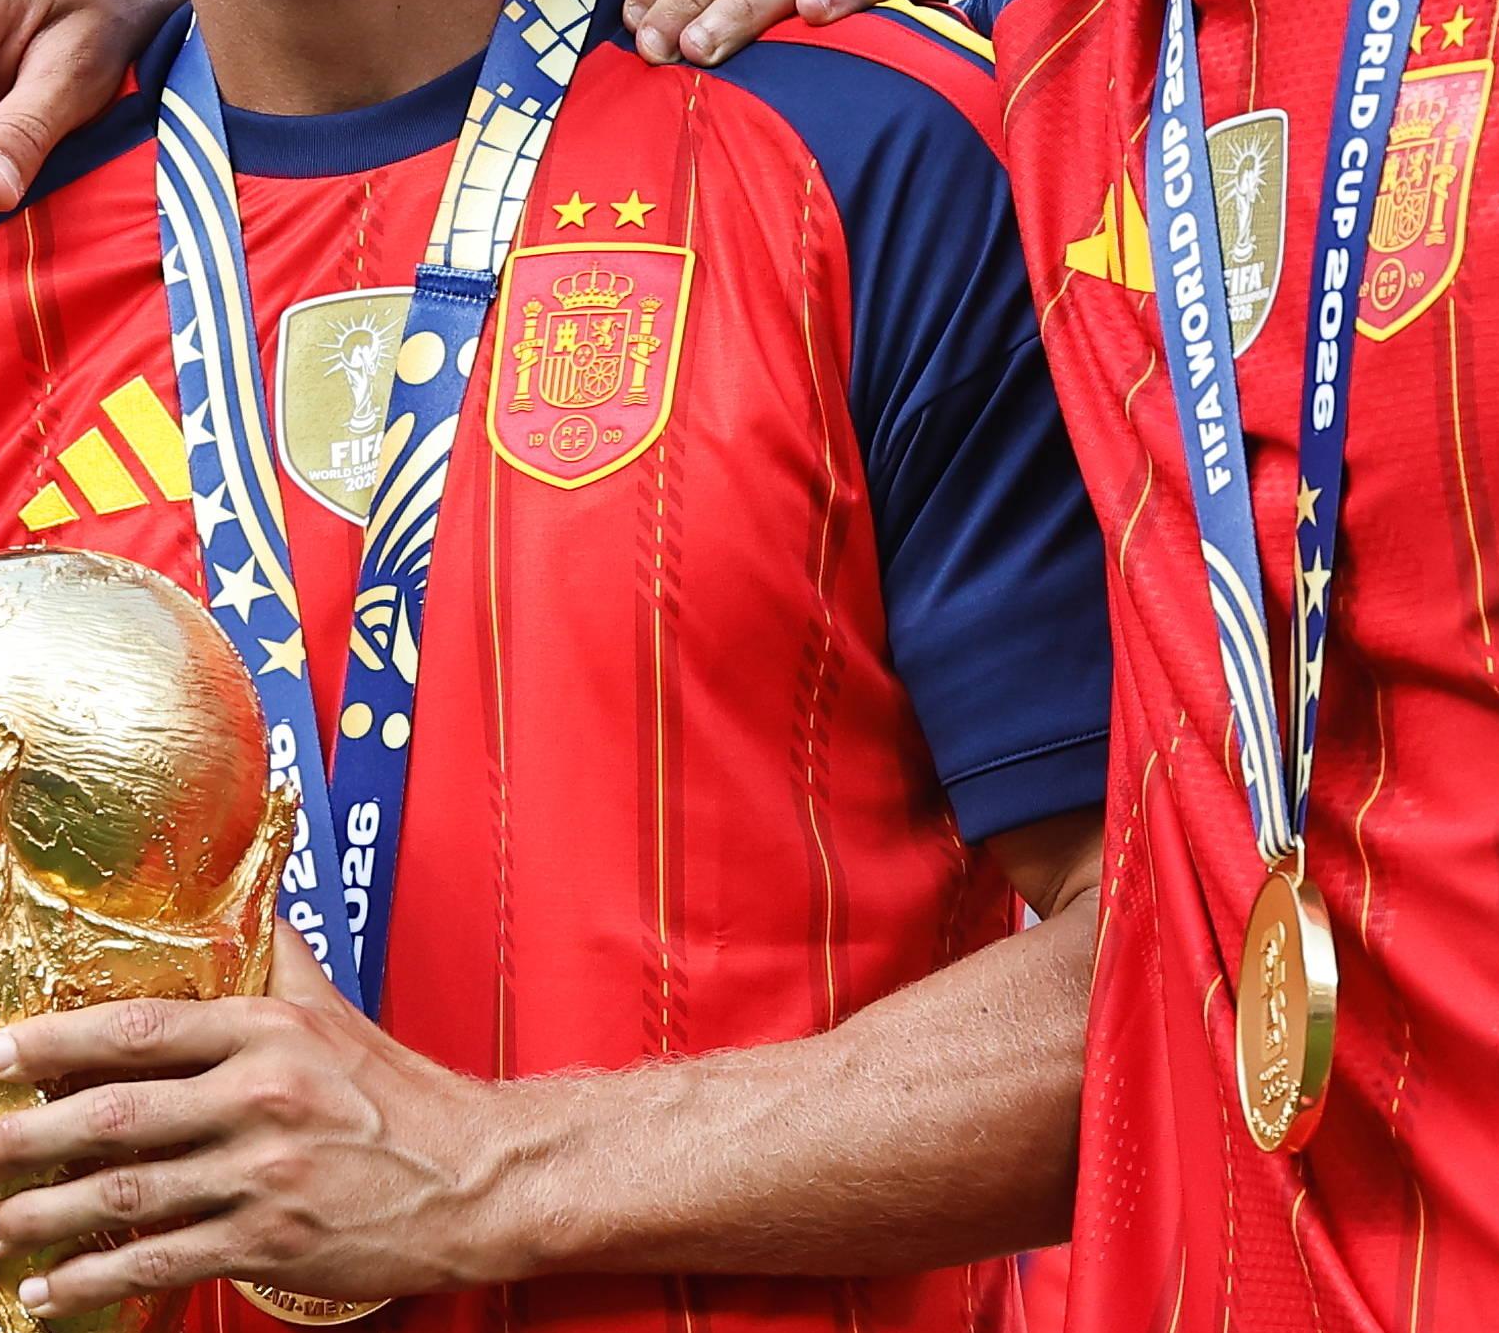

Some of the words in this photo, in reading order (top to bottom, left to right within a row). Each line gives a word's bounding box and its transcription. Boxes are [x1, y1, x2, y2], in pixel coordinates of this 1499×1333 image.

[1162, 116, 1193, 199] CUP
[1331, 137, 1371, 239] CUP
[1170, 220, 1223, 385] WORLD
[1311, 247, 1353, 433] 2026
[308, 466, 352, 481] WORLD
[528, 433, 544, 447] 19
[560, 439, 587, 451] EF
[561, 427, 588, 437] RF
[1192, 385, 1231, 496] FIFA
